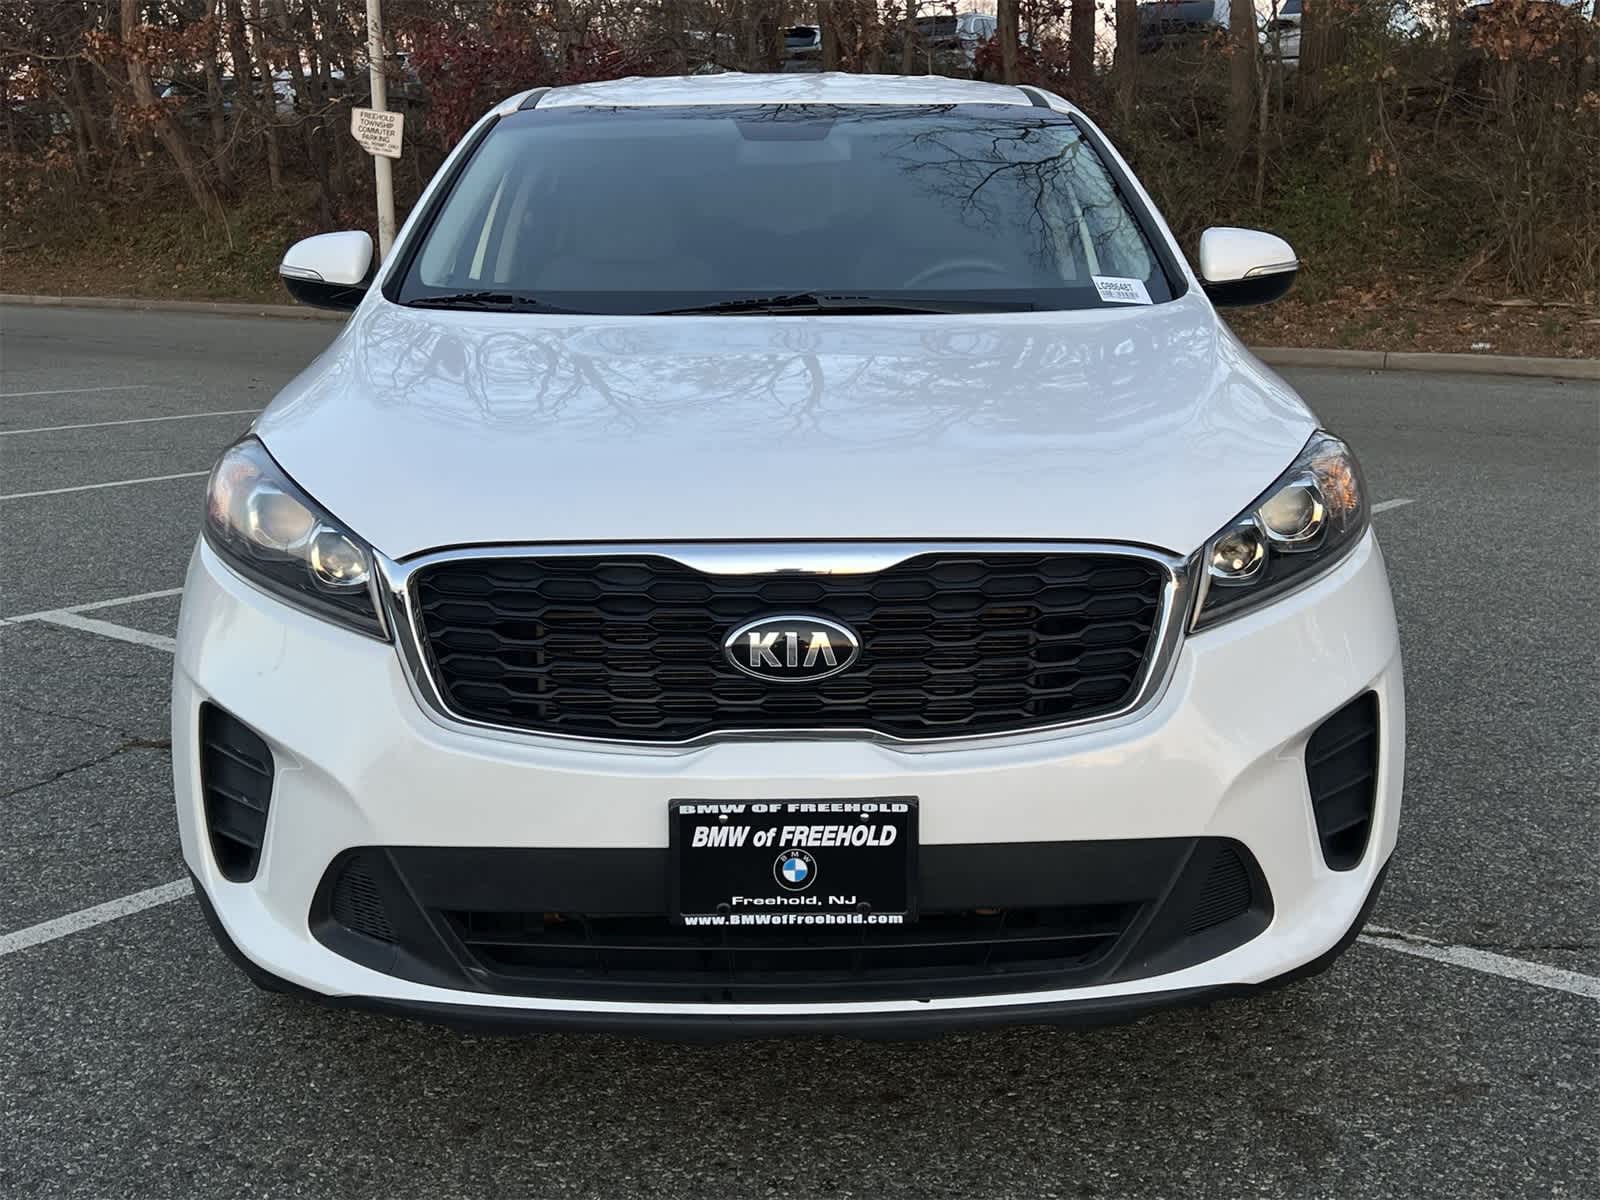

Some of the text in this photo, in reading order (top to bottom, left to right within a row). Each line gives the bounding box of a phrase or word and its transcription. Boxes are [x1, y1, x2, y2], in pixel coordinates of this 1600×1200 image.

[748, 632, 837, 667] KIA
[680, 804, 908, 814] BMW OF FREEHOLD
[692, 825, 896, 848] BMW of FREEHOLD
[732, 896, 856, 905] Freehold, NJ
[685, 914, 904, 925] www.BMWofFreehold.com
